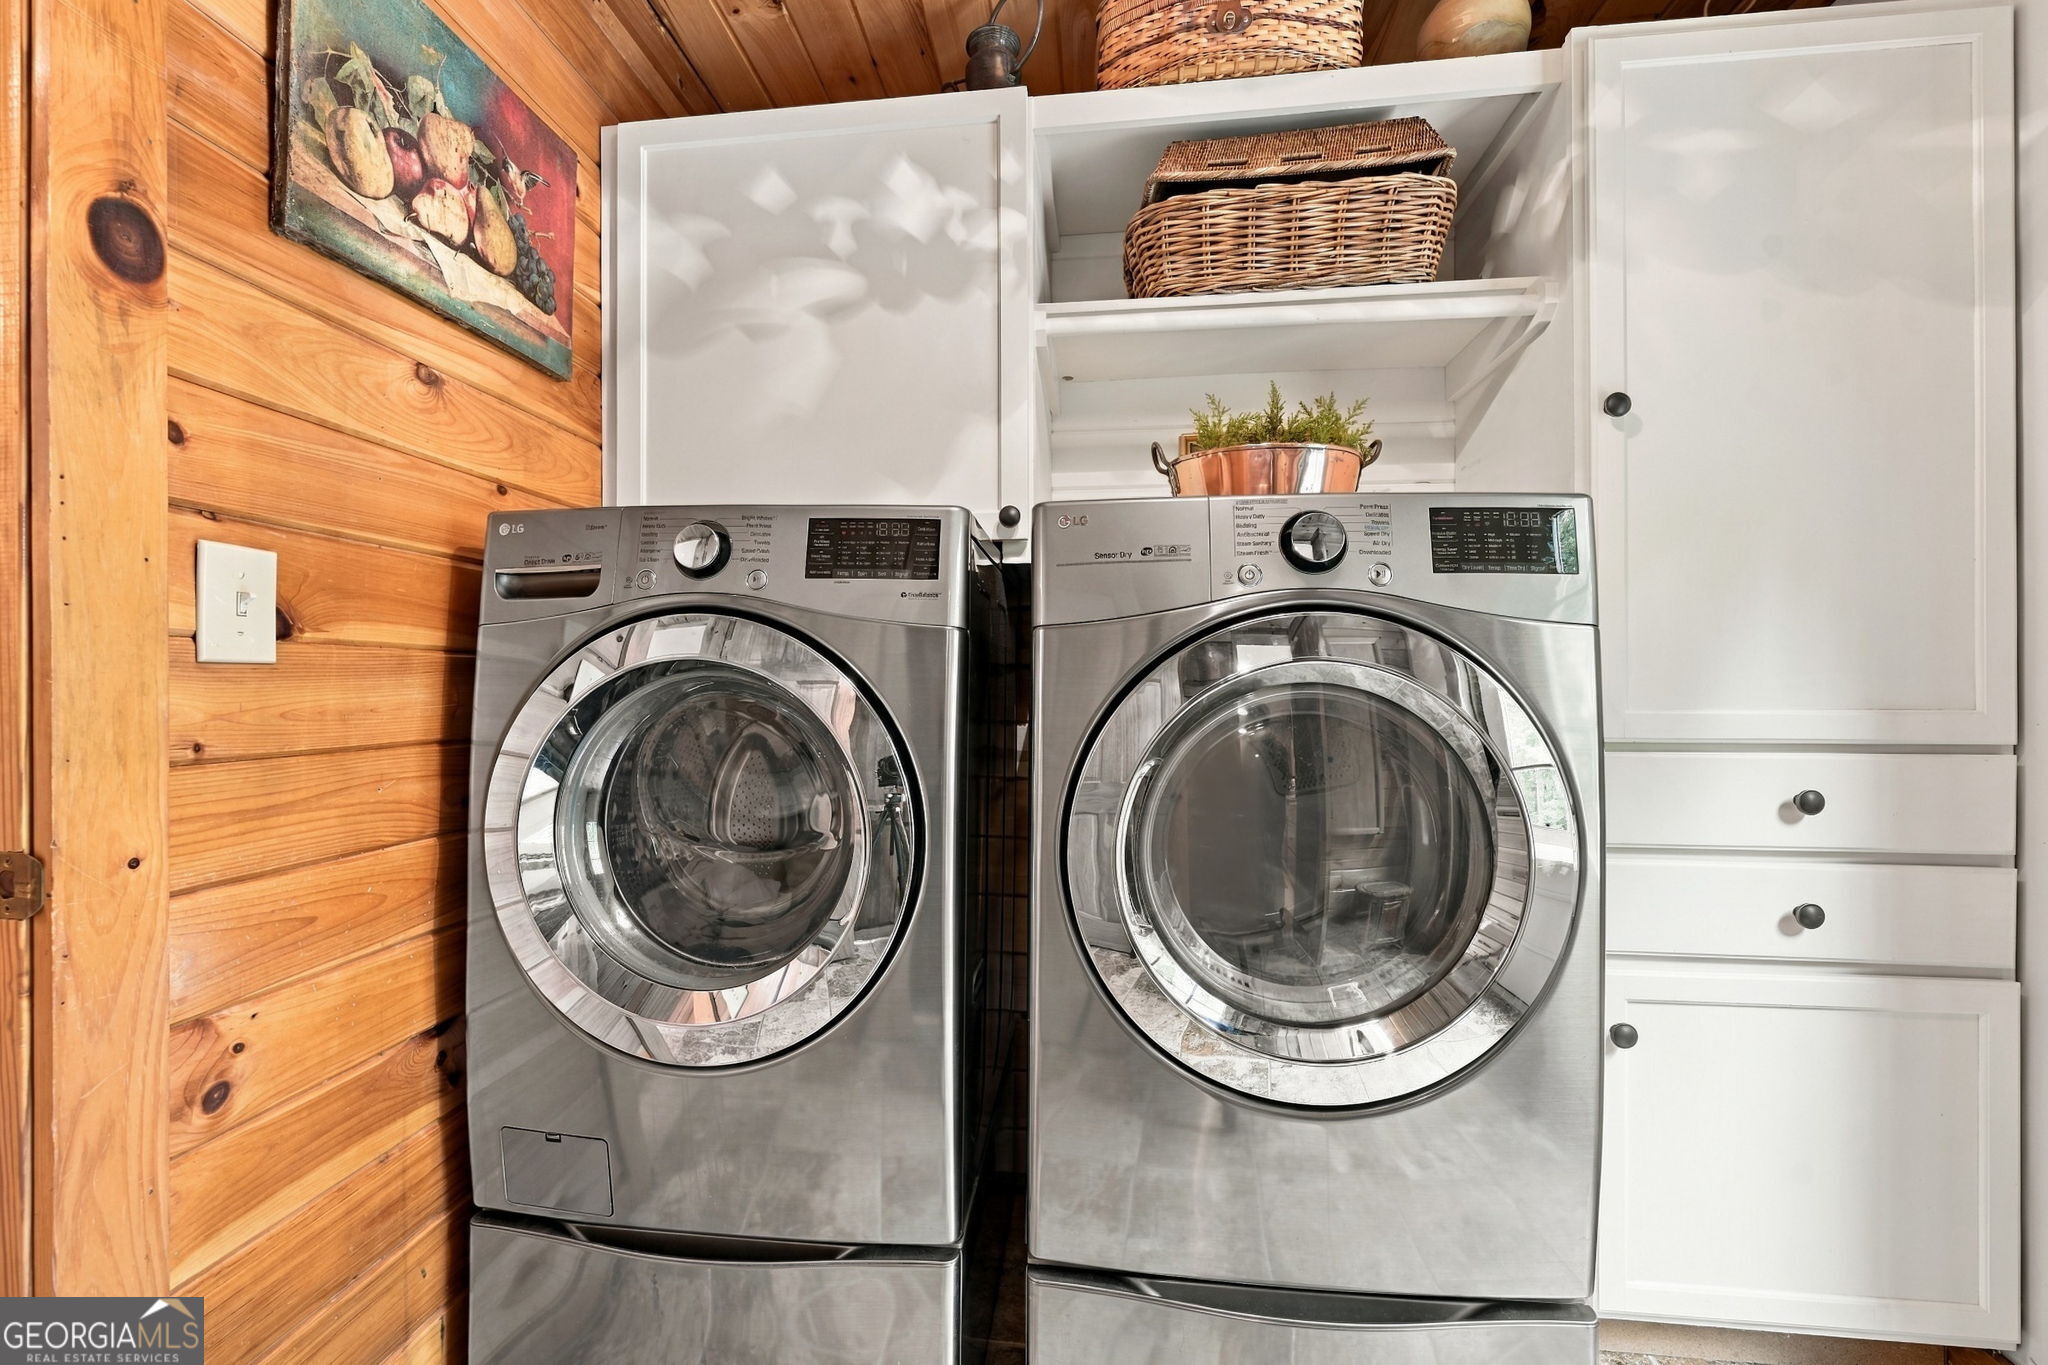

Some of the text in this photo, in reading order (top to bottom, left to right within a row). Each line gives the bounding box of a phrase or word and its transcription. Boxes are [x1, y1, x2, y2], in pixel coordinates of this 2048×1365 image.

[1073, 515, 1089, 527] LG
[511, 523, 525, 534] LG
[1094, 552, 1118, 560] Sensor
[1119, 551, 1133, 560] Dry
[523, 559, 541, 567] Direct
